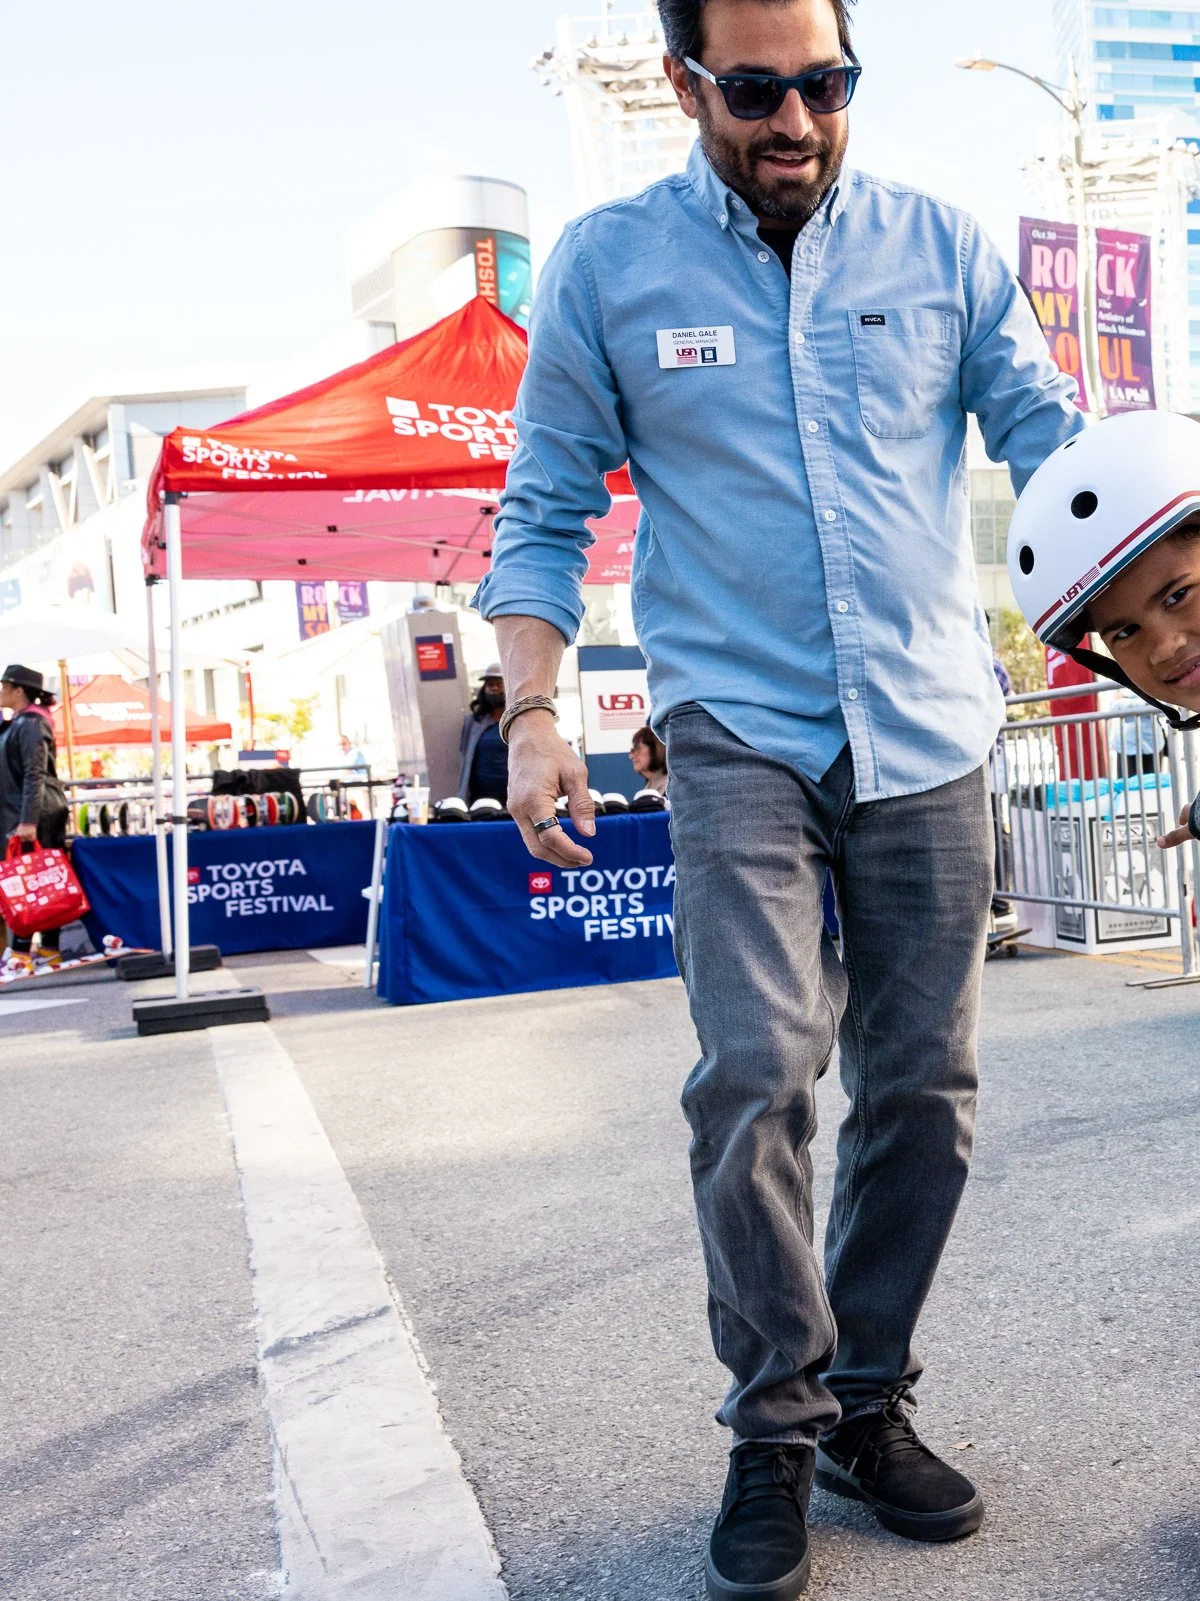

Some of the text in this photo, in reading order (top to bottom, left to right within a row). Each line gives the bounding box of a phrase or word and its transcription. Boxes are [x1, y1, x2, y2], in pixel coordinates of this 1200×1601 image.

[1031, 291, 1073, 328] MY
[672, 331, 698, 339] DANIEL
[182, 446, 271, 472] SPORTS
[205, 858, 307, 882] TOYOTA
[560, 864, 677, 893] TOYOTA
[187, 878, 275, 904] SPORTS
[225, 894, 334, 918] FESTIVAL
[529, 892, 645, 920] SPORTS
